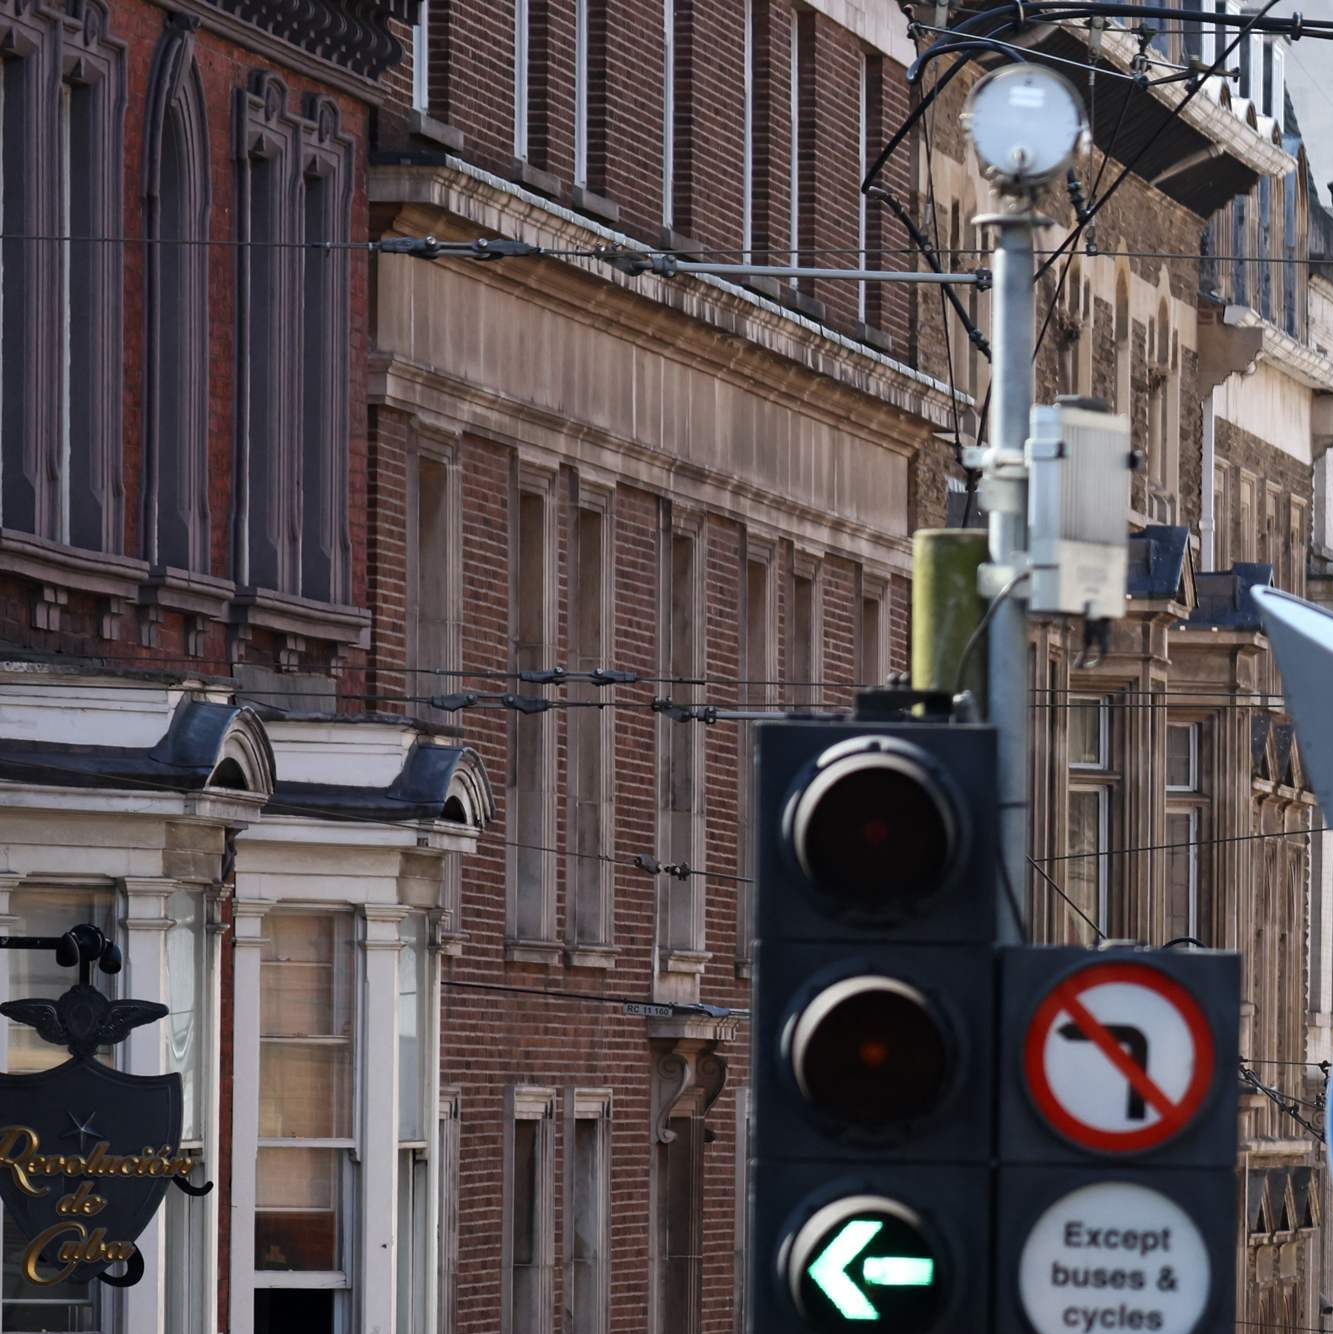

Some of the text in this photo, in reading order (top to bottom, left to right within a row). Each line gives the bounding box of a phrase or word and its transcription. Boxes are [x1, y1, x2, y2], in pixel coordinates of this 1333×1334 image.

[0, 1125, 193, 1196] Revolución
[56, 1181, 107, 1216] de
[22, 1221, 138, 1287] Cuba
[1063, 1221, 1171, 1256] Except
[1051, 1261, 1179, 1292] buses &
[1062, 1303, 1164, 1334] cycles
